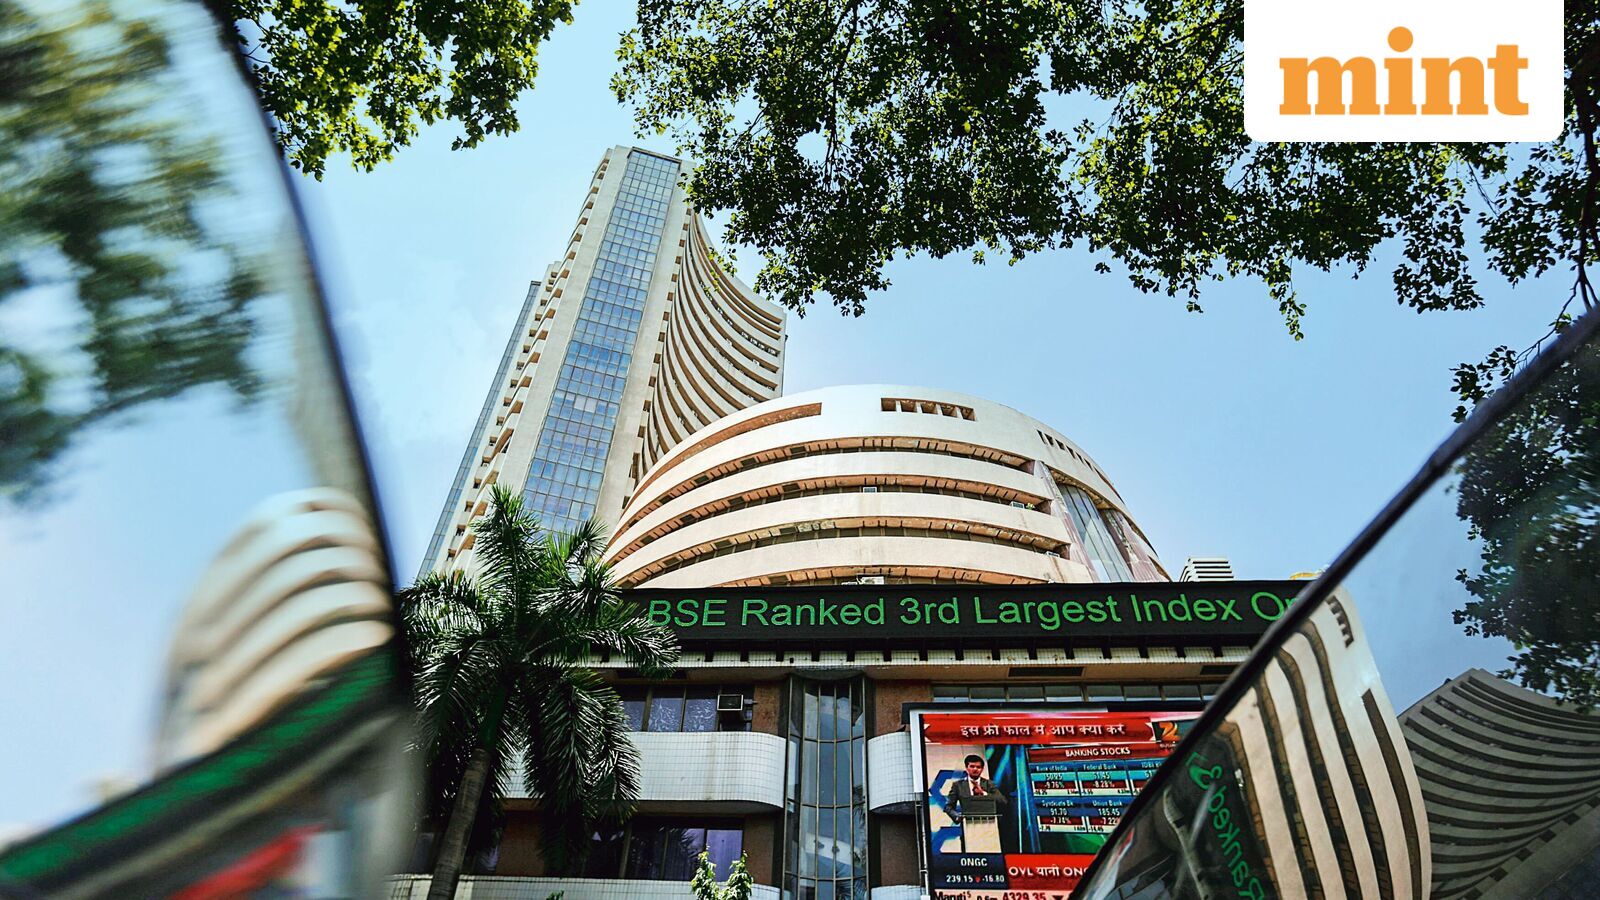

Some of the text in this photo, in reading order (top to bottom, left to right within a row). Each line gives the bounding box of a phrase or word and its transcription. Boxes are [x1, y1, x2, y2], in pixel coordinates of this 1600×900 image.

[649, 599, 727, 627] BSE
[741, 598, 885, 626] Ranked
[899, 597, 960, 625] 3rd
[973, 596, 1122, 631] Largest
[1130, 593, 1243, 622] Index
[960, 725, 979, 738] इस
[1049, 724, 1075, 736] आप
[1078, 724, 1102, 735] क्या
[1065, 746, 1131, 757] BANKING STOCKS
[960, 857, 988, 867] ONGC
[1008, 866, 1034, 876] OVL
[946, 875, 974, 883] 239.15
